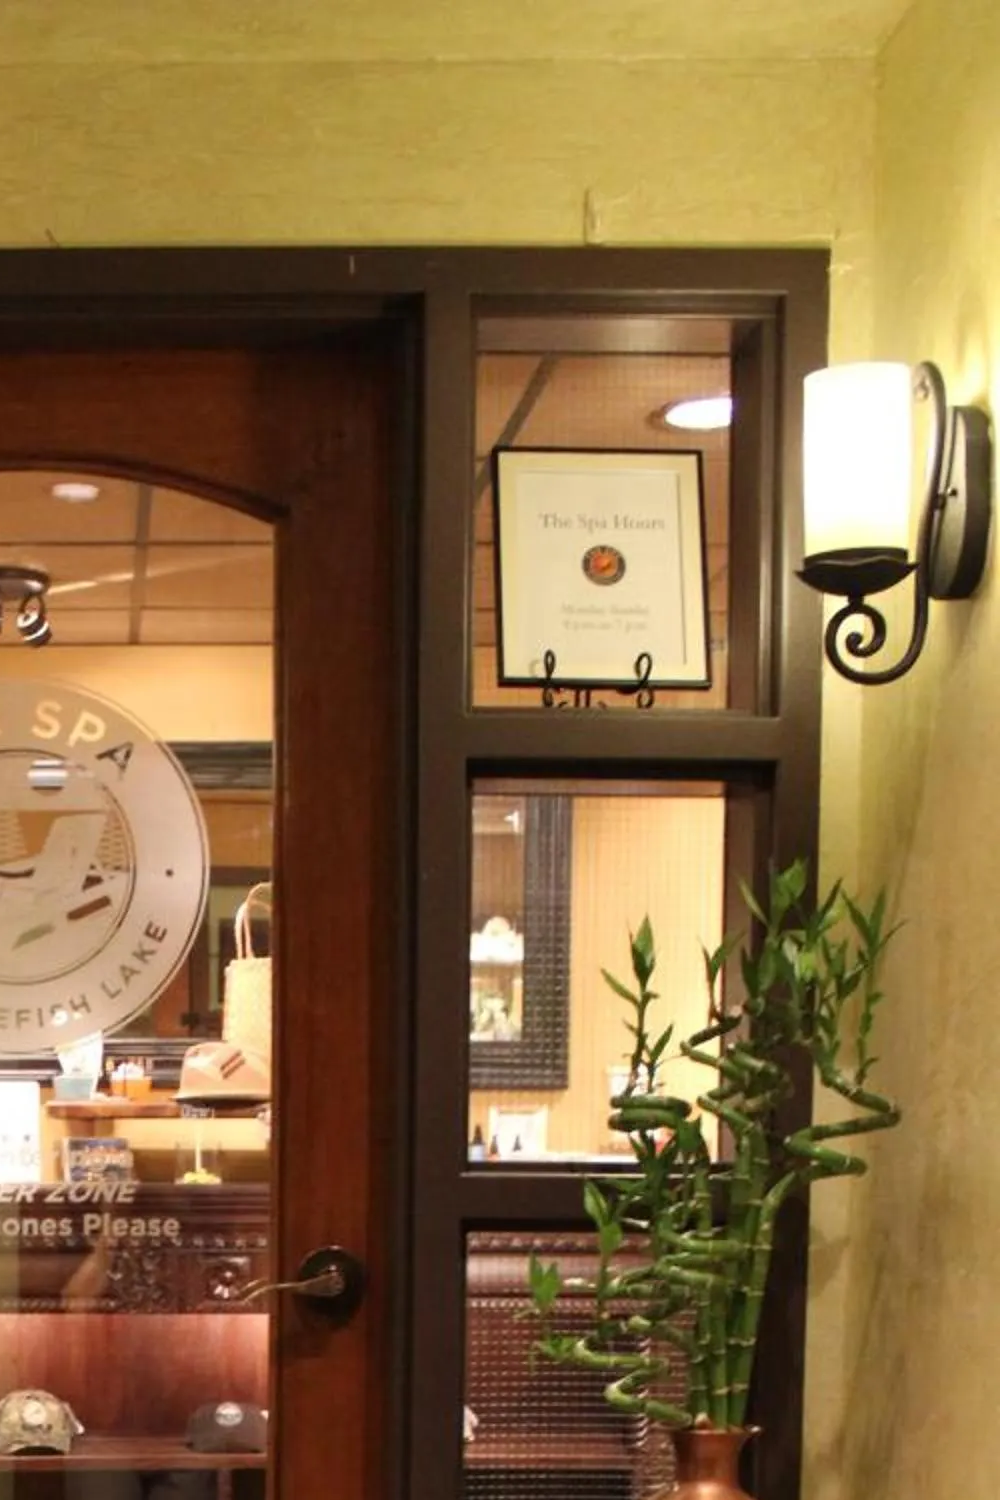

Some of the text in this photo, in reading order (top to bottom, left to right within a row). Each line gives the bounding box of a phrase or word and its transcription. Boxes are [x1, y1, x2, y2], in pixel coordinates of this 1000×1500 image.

[32, 699, 135, 780] SPA
[100, 921, 168, 1000] LAKE
[44, 1181, 137, 1204] ZONE
[83, 1213, 181, 1237] Please
